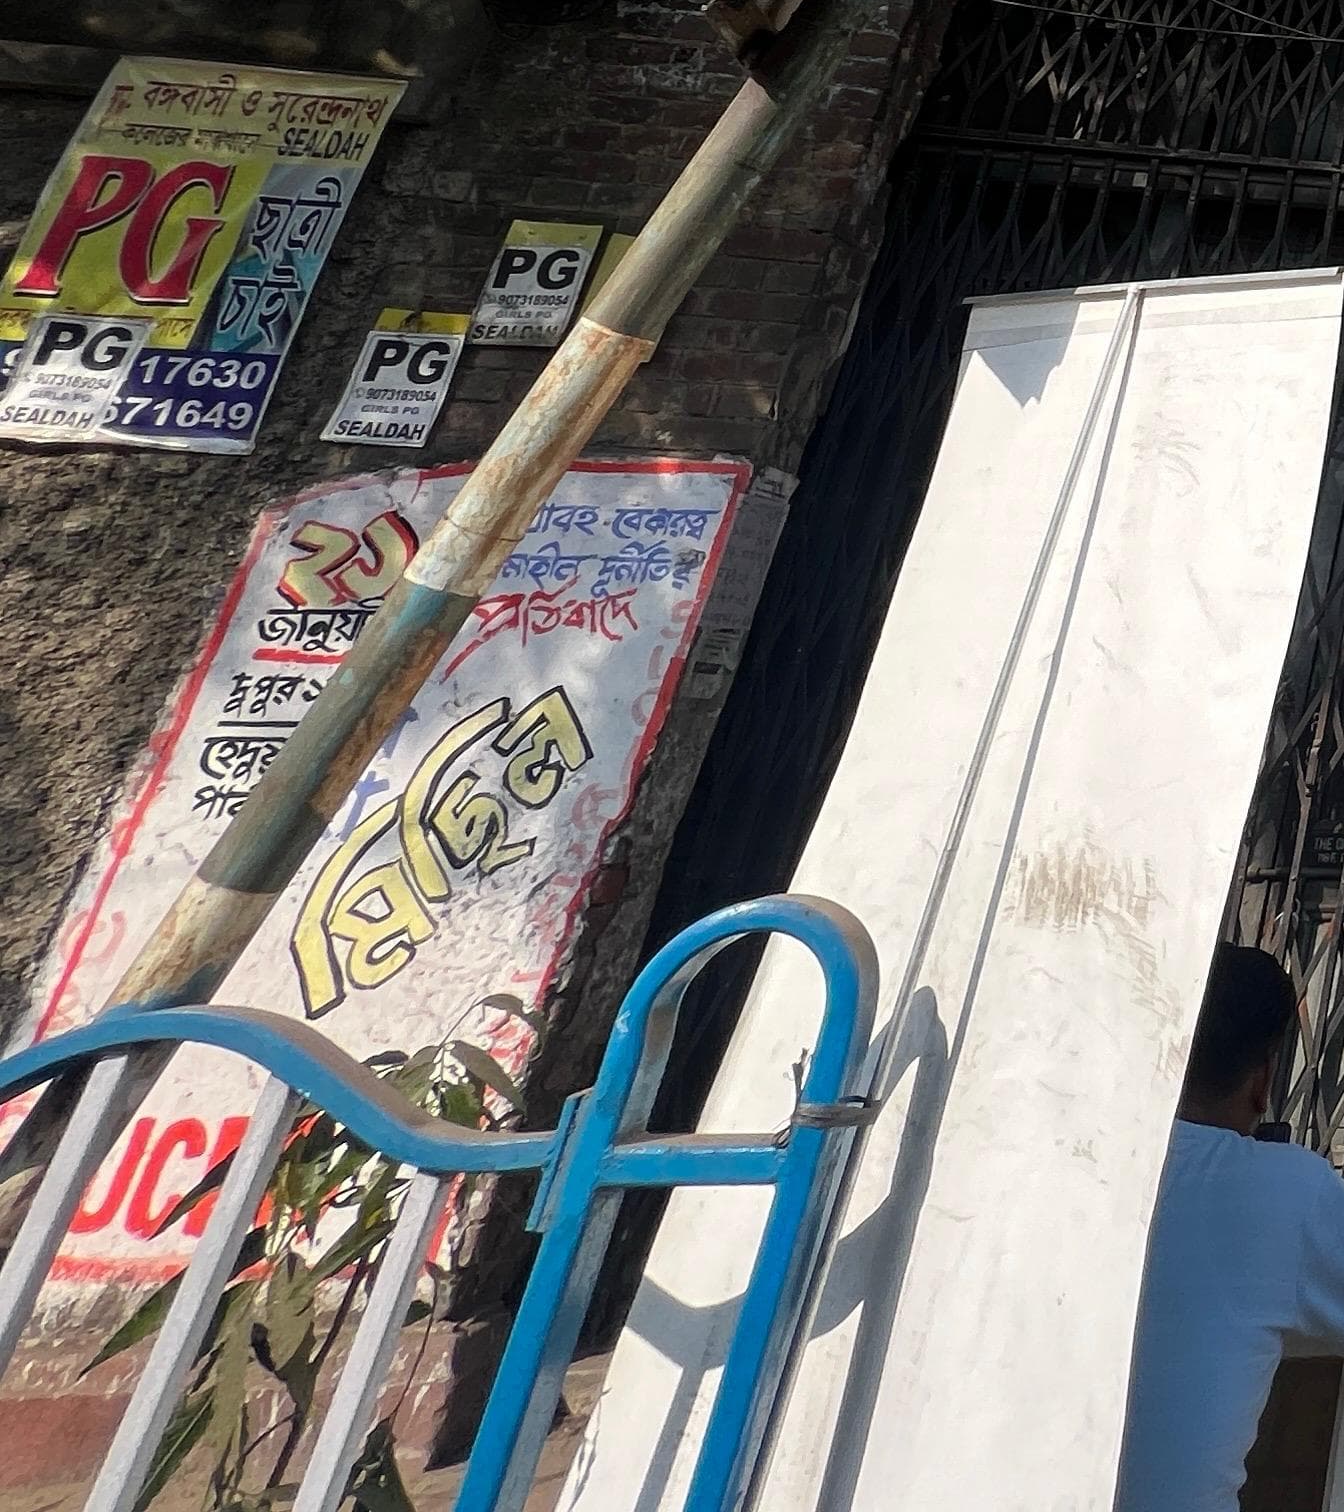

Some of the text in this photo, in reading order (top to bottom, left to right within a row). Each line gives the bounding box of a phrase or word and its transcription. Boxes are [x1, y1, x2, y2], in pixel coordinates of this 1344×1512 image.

[277, 126, 370, 161] SEALDAH
[14, 155, 237, 307] PG
[249, 176, 344, 265] ছাত্রী
[492, 248, 581, 290] PG
[216, 262, 300, 346] চাই
[32, 321, 134, 372] PG
[362, 339, 451, 385] PG
[0, 405, 95, 430] SEALDAH
[365, 389, 437, 402] 9073189054
[334, 420, 426, 440] SEALDAH
